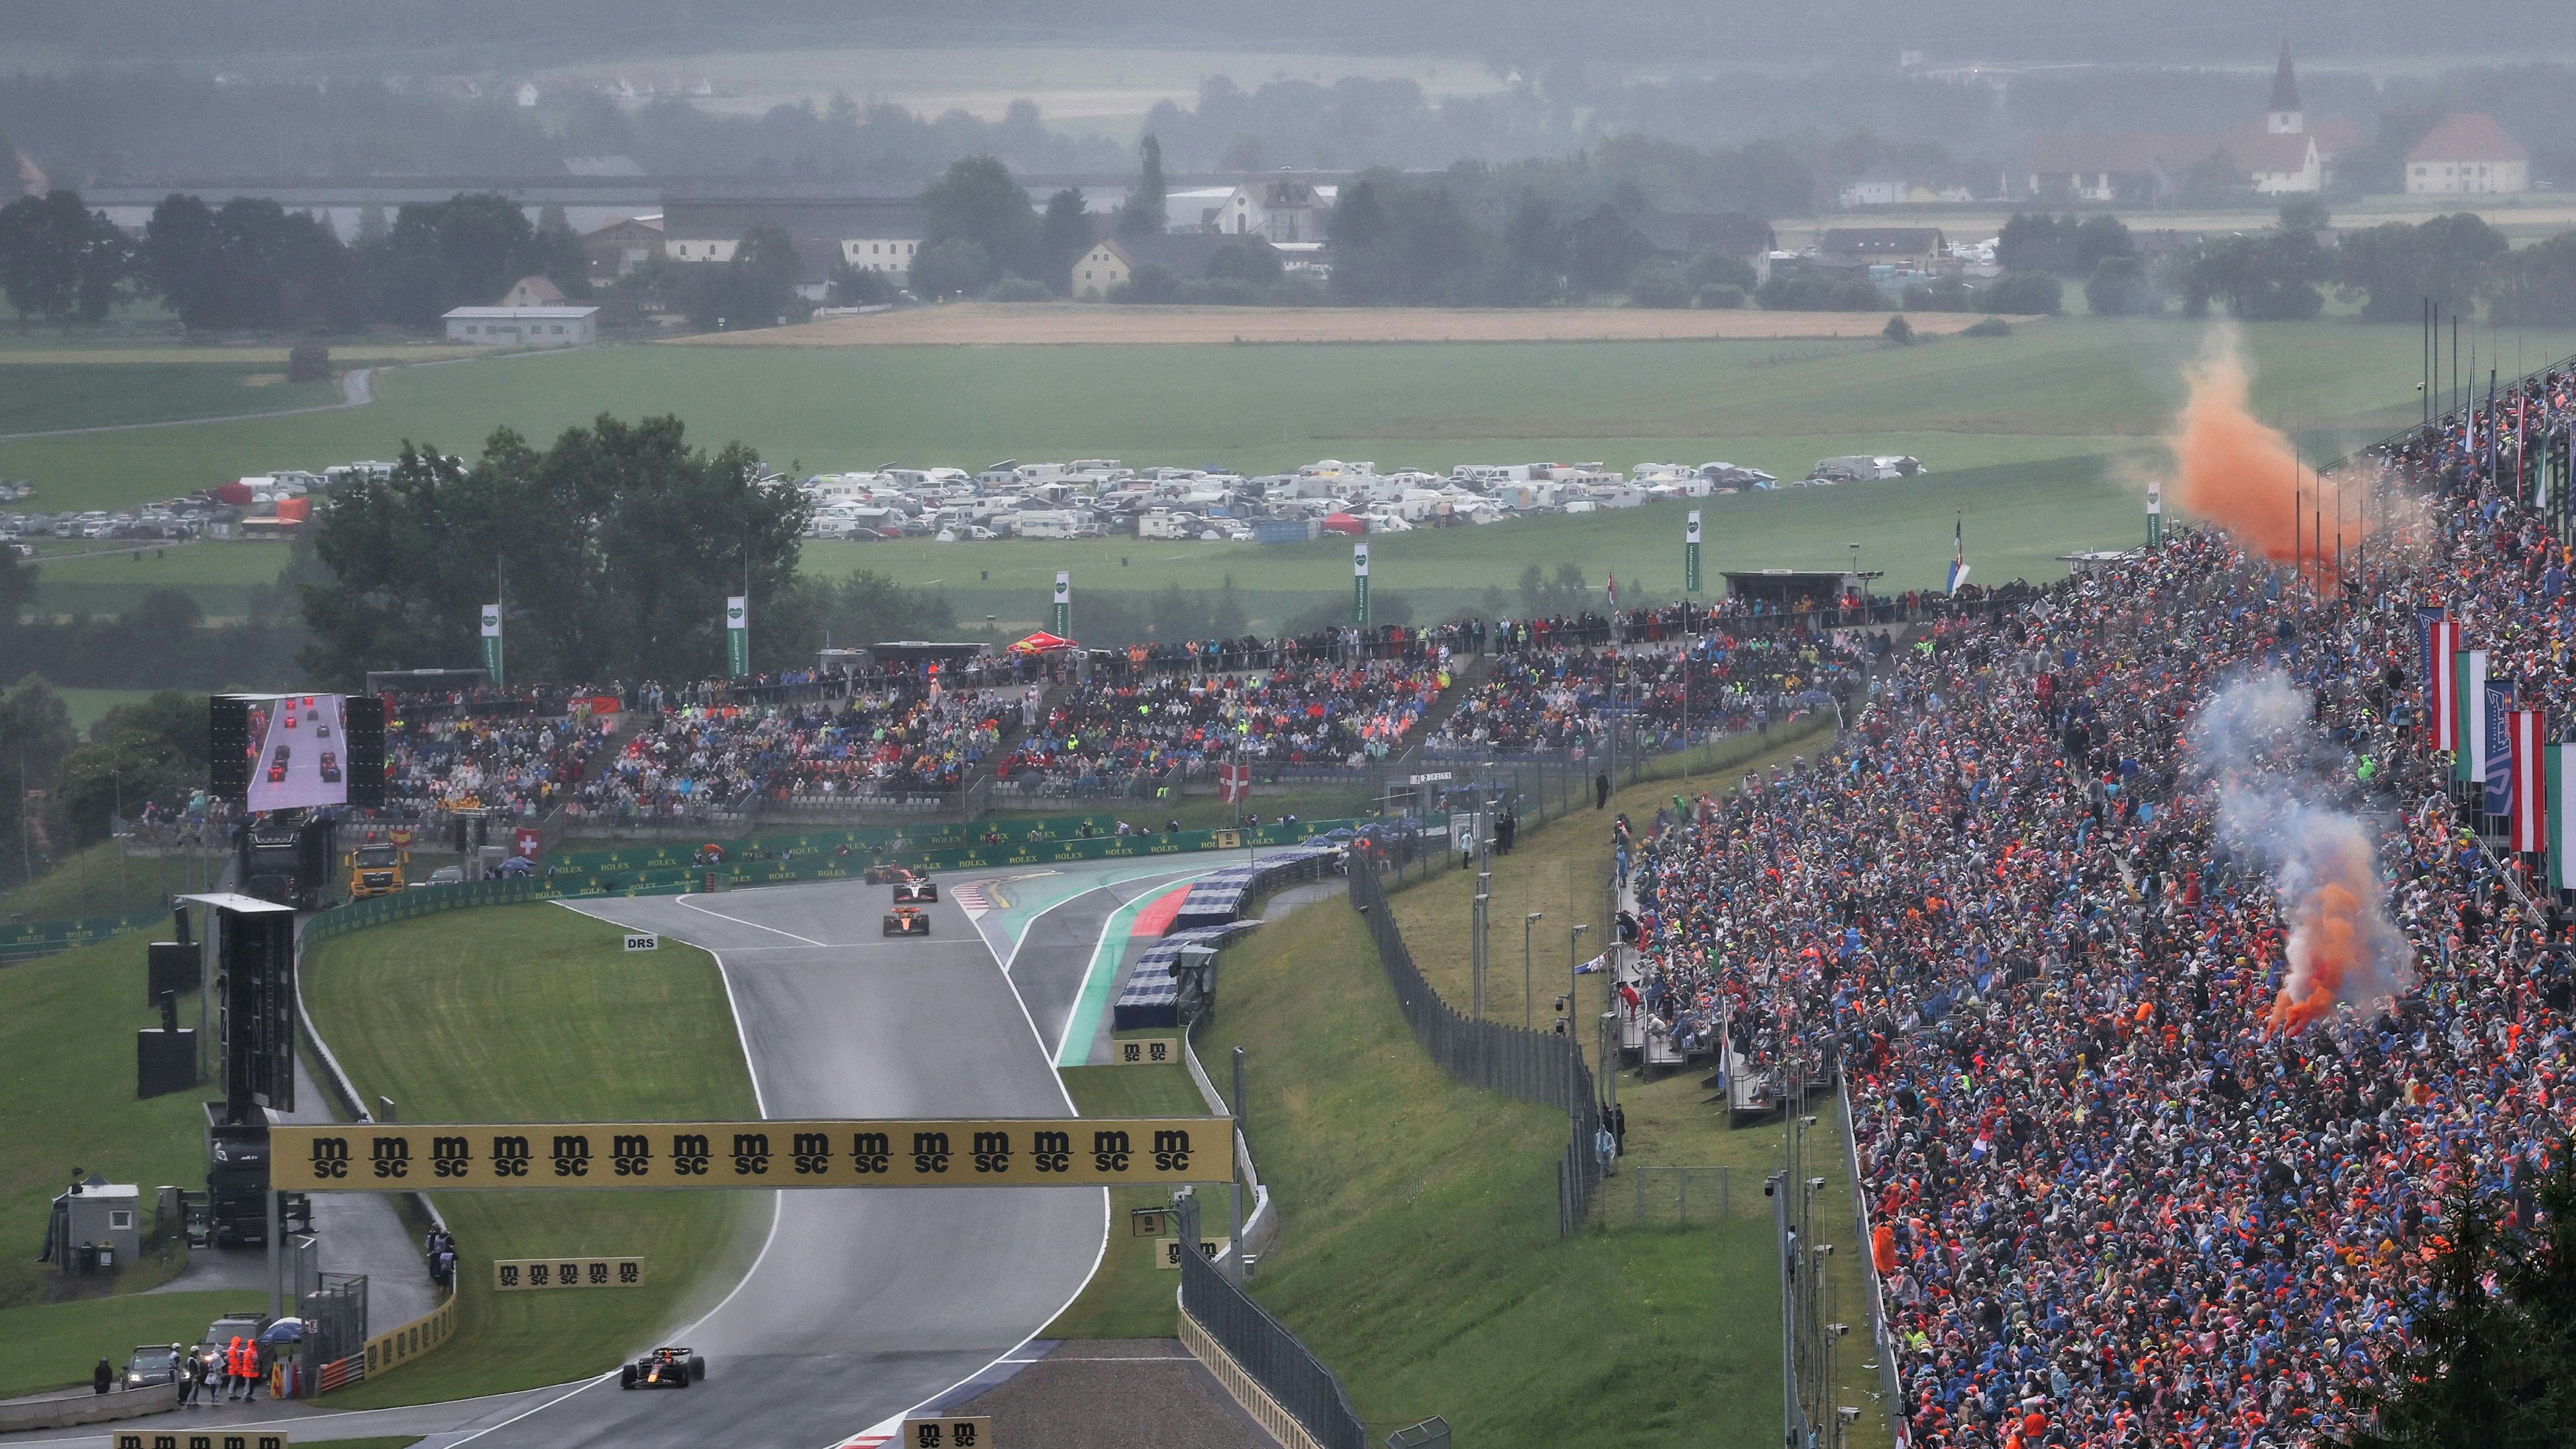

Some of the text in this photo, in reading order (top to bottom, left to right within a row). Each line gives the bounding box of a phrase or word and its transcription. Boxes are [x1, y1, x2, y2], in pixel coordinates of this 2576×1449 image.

[601, 862, 629, 871] ROLEX
[648, 859, 676, 867] ROLEX
[535, 890, 563, 899] ROLEX
[628, 939, 654, 948] DRS
